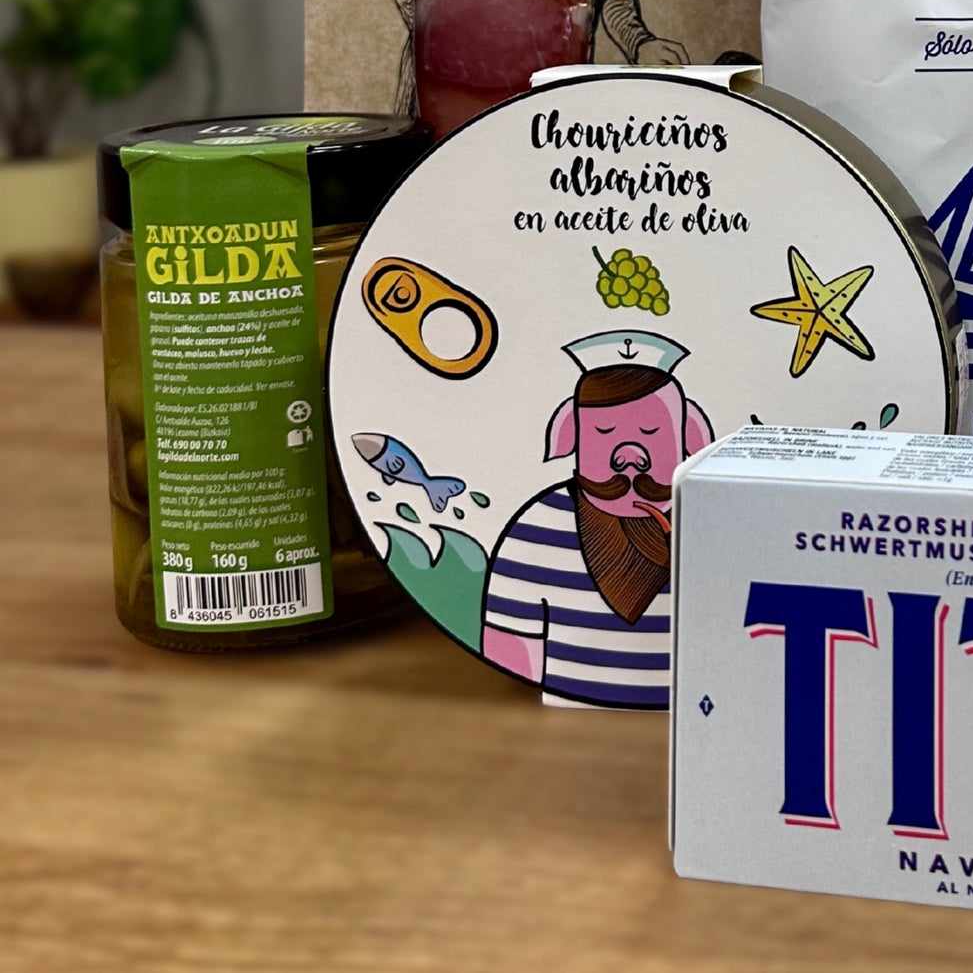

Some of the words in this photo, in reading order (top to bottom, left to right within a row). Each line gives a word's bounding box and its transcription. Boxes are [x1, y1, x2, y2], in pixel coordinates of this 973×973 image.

[530, 109, 728, 154] Chouriciños
[550, 155, 712, 201] albariños
[514, 210, 547, 233] en
[554, 207, 634, 235] aceite
[641, 202, 675, 235] de
[681, 202, 751, 236] oliva
[146, 219, 298, 244] ANTXOADUN
[199, 290, 221, 305] DE
[227, 285, 304, 303] ANCHOA
[206, 324, 236, 333] anchoa
[237, 322, 262, 332] (24%)
[268, 319, 291, 329] aceite
[291, 317, 301, 327] de
[172, 337, 194, 346] Puede
[195, 335, 228, 345] contener
[230, 334, 255, 344] trazas
[256, 333, 266, 342] de
[185, 347, 218, 359] molusco,
[219, 347, 244, 357] huevo
[245, 349, 251, 358] y
[252, 345, 275, 355] leche.
[240, 359, 267, 369] tapado
[273, 354, 304, 365] cubierto
[206, 385, 216, 395] de
[256, 382, 268, 391] Ver
[216, 416, 230, 425] 126
[173, 439, 189, 449] 690
[190, 440, 201, 449] 00
[202, 440, 214, 449] 70
[215, 440, 227, 449] 70
[265, 468, 279, 477] 100
[162, 538, 175, 550] Peso
[211, 541, 227, 551] Peso
[273, 533, 307, 546] Unidades
[162, 551, 183, 566] 380
[184, 555, 193, 571] g
[212, 553, 236, 568] 160
[238, 554, 248, 570] g
[275, 549, 284, 562] 6
[285, 545, 320, 564] aprox.
[169, 609, 177, 620] 8
[188, 610, 233, 622] 436045
[249, 604, 297, 620] 061515
[936, 880, 959, 896] AL
